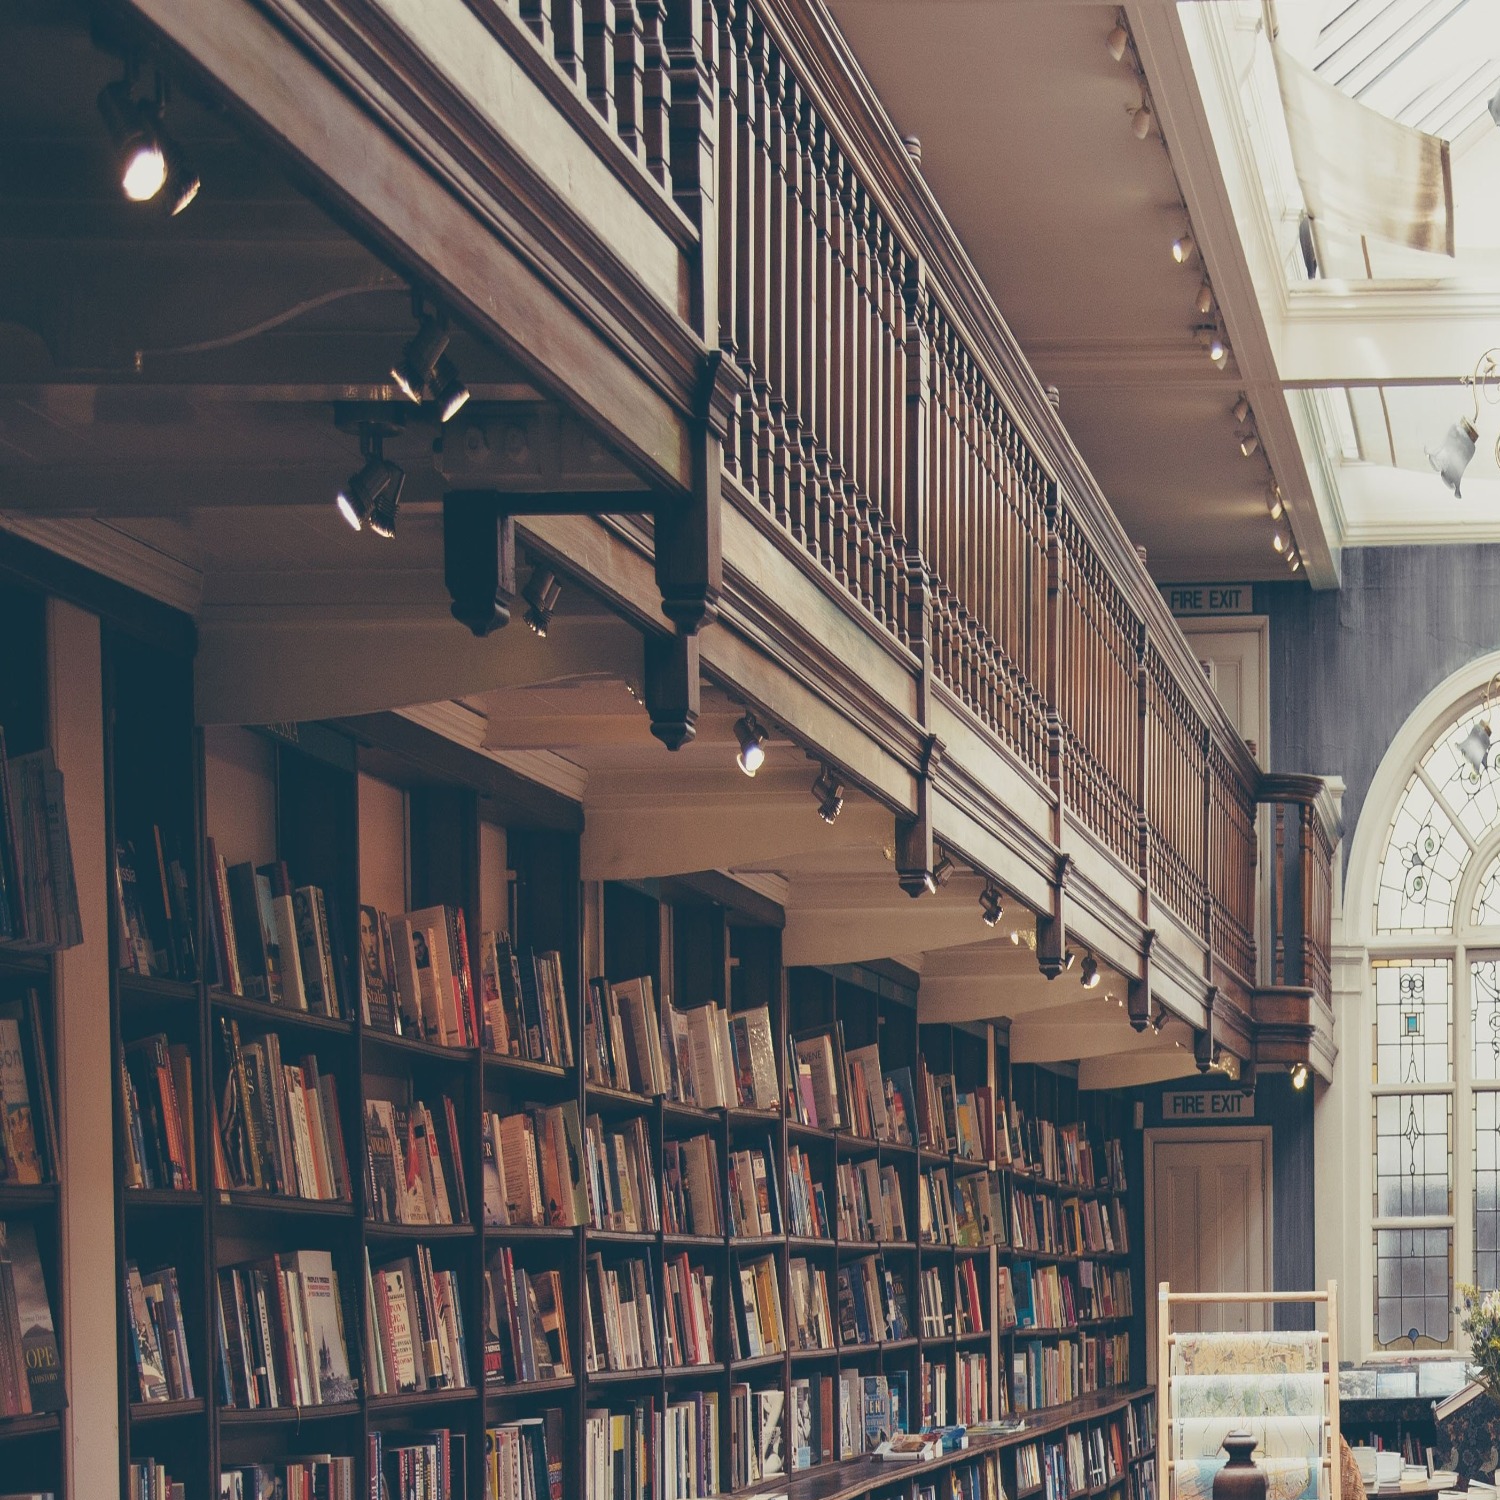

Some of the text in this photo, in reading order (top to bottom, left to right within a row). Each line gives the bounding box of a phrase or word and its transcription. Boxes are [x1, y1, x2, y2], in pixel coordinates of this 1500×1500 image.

[1171, 589, 1242, 609] FIRE EXIT
[367, 989, 388, 1005] Stalin
[1173, 1094, 1243, 1114] FIRE EXIT
